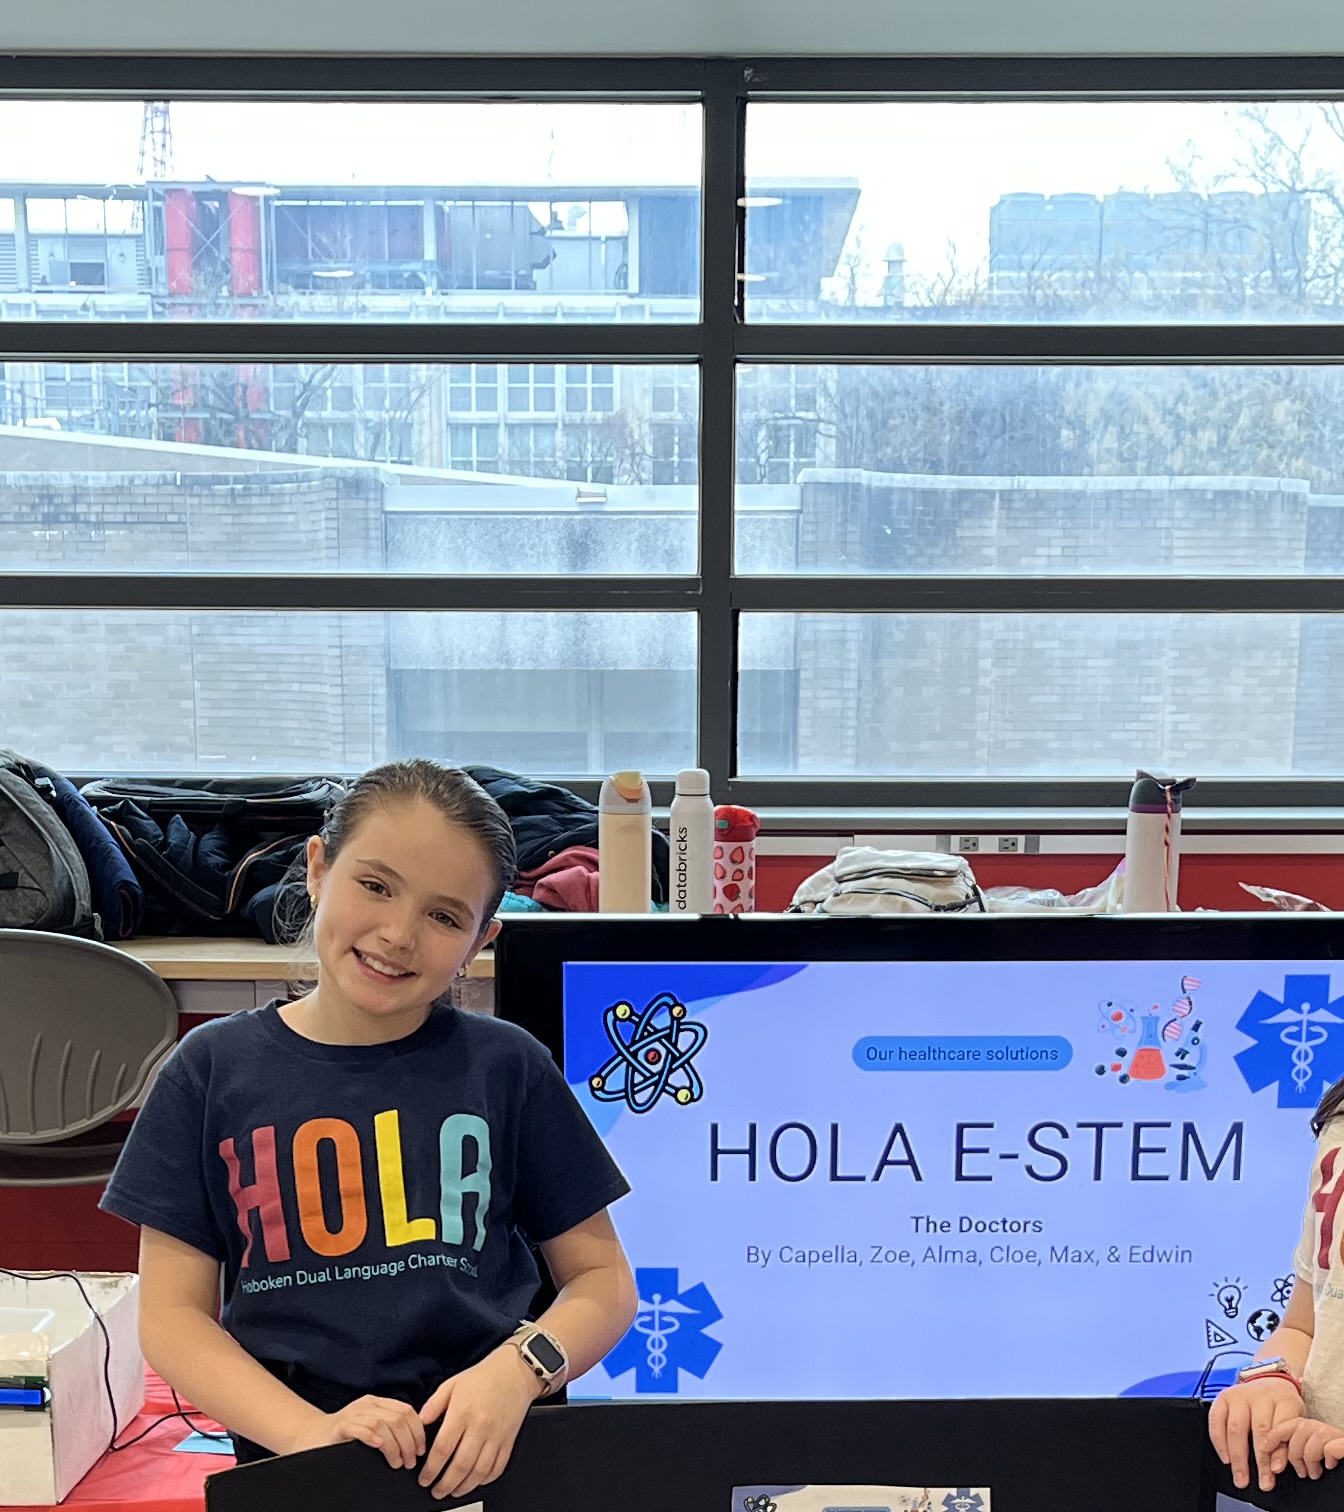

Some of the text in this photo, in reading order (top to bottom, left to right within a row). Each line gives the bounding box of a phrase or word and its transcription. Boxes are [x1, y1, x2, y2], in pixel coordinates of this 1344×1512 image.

[675, 826, 688, 910] databricks
[866, 1045, 1059, 1061] Our healthcare solutions
[709, 1120, 1245, 1183] HOLA E-STEM
[219, 1109, 492, 1268] HOLA
[910, 1216, 1043, 1234] The Doctors
[296, 1267, 333, 1285] Dual
[335, 1260, 406, 1281] Language
[408, 1253, 458, 1270] Charter
[746, 1245, 1193, 1268] By Capella, Zoe, Alma, Cloe, Max, & Edwin
